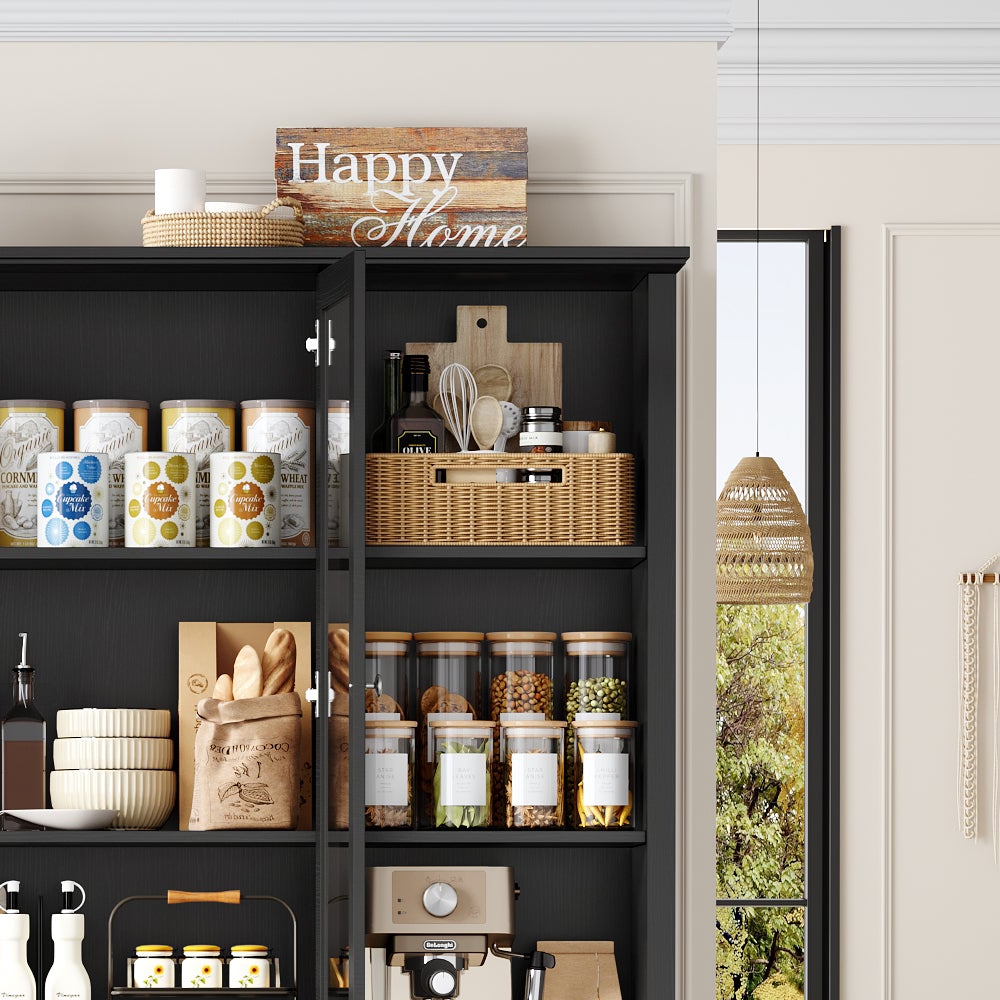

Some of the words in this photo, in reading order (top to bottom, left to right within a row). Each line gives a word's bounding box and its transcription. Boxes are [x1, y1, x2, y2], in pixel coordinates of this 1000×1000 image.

[287, 142, 463, 197] Happy
[351, 186, 527, 248] Home
[0, 427, 51, 470] Organic
[0, 471, 37, 484] CORNM
[280, 473, 308, 483] WHEAT
[56, 494, 90, 504] Cupcake
[144, 494, 178, 504] Cupcake
[69, 503, 87, 513] Mix
[156, 503, 174, 513] Mix
[243, 503, 259, 512] Mix
